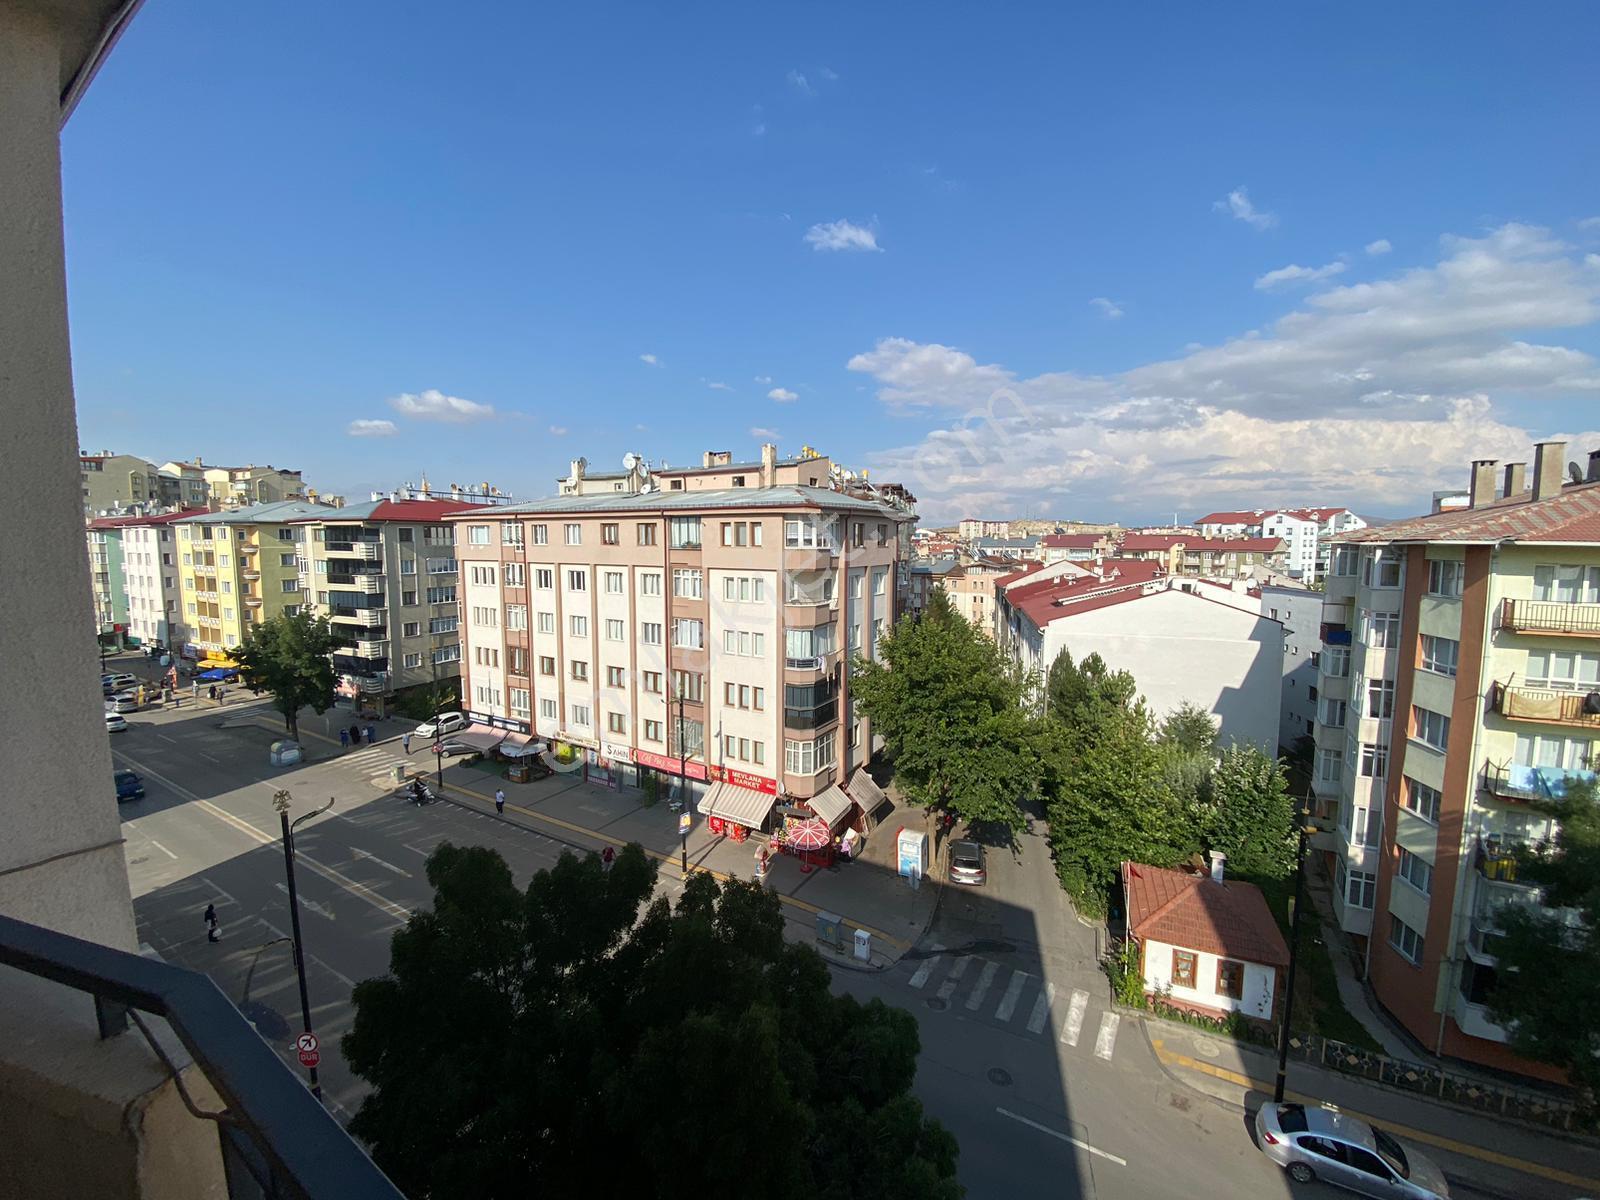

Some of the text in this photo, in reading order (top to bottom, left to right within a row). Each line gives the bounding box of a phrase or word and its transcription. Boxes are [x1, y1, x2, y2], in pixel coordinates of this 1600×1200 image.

[732, 770, 763, 784] MEVLANA
[734, 778, 761, 789] MARKET
[300, 1053, 318, 1061] DUR
